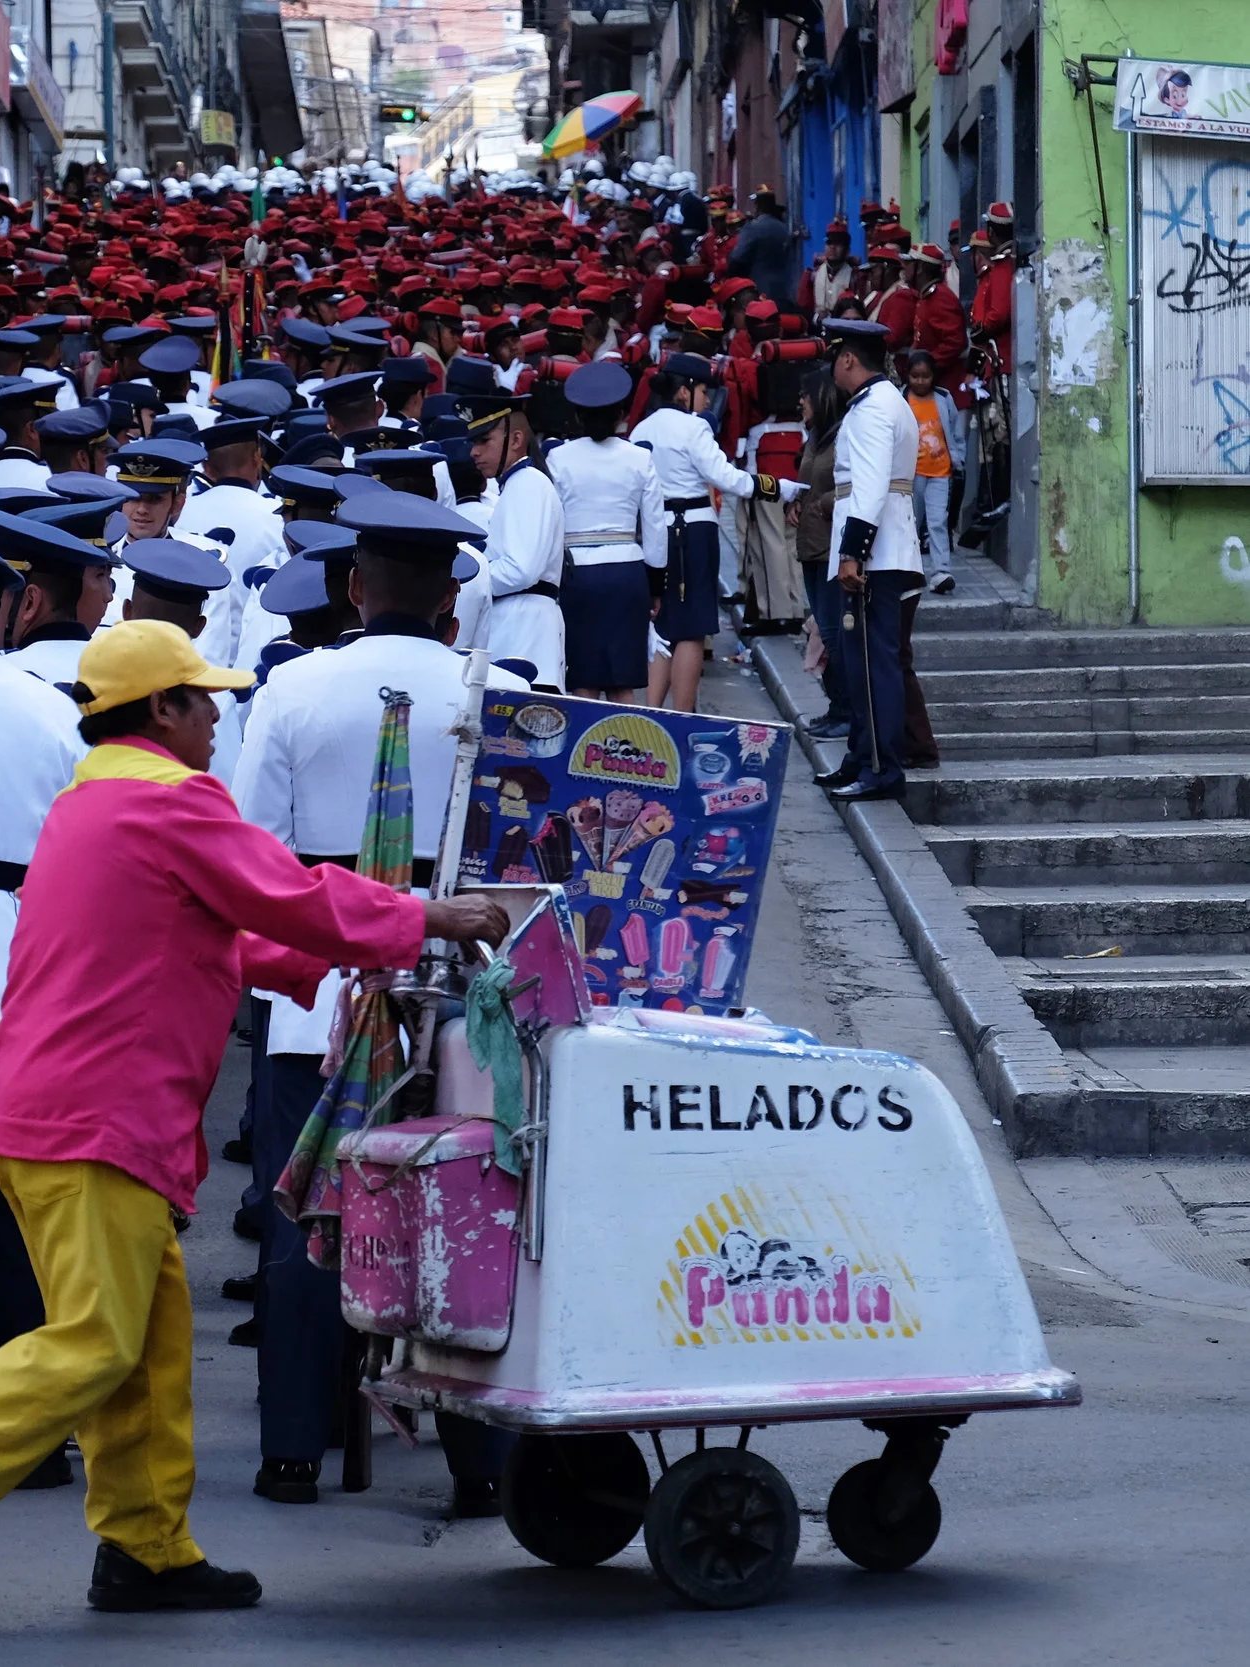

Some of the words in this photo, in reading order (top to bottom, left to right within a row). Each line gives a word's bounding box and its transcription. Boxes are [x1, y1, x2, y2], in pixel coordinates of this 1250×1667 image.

[1137, 117, 1192, 130] ESTAMOS
[1198, 124, 1207, 133] A
[1209, 123, 1225, 132] LA
[584, 742, 668, 779] Panda
[458, 865, 487, 877] ANDA
[622, 1084, 913, 1133] HELADOS
[685, 1255, 892, 1329] Panda
